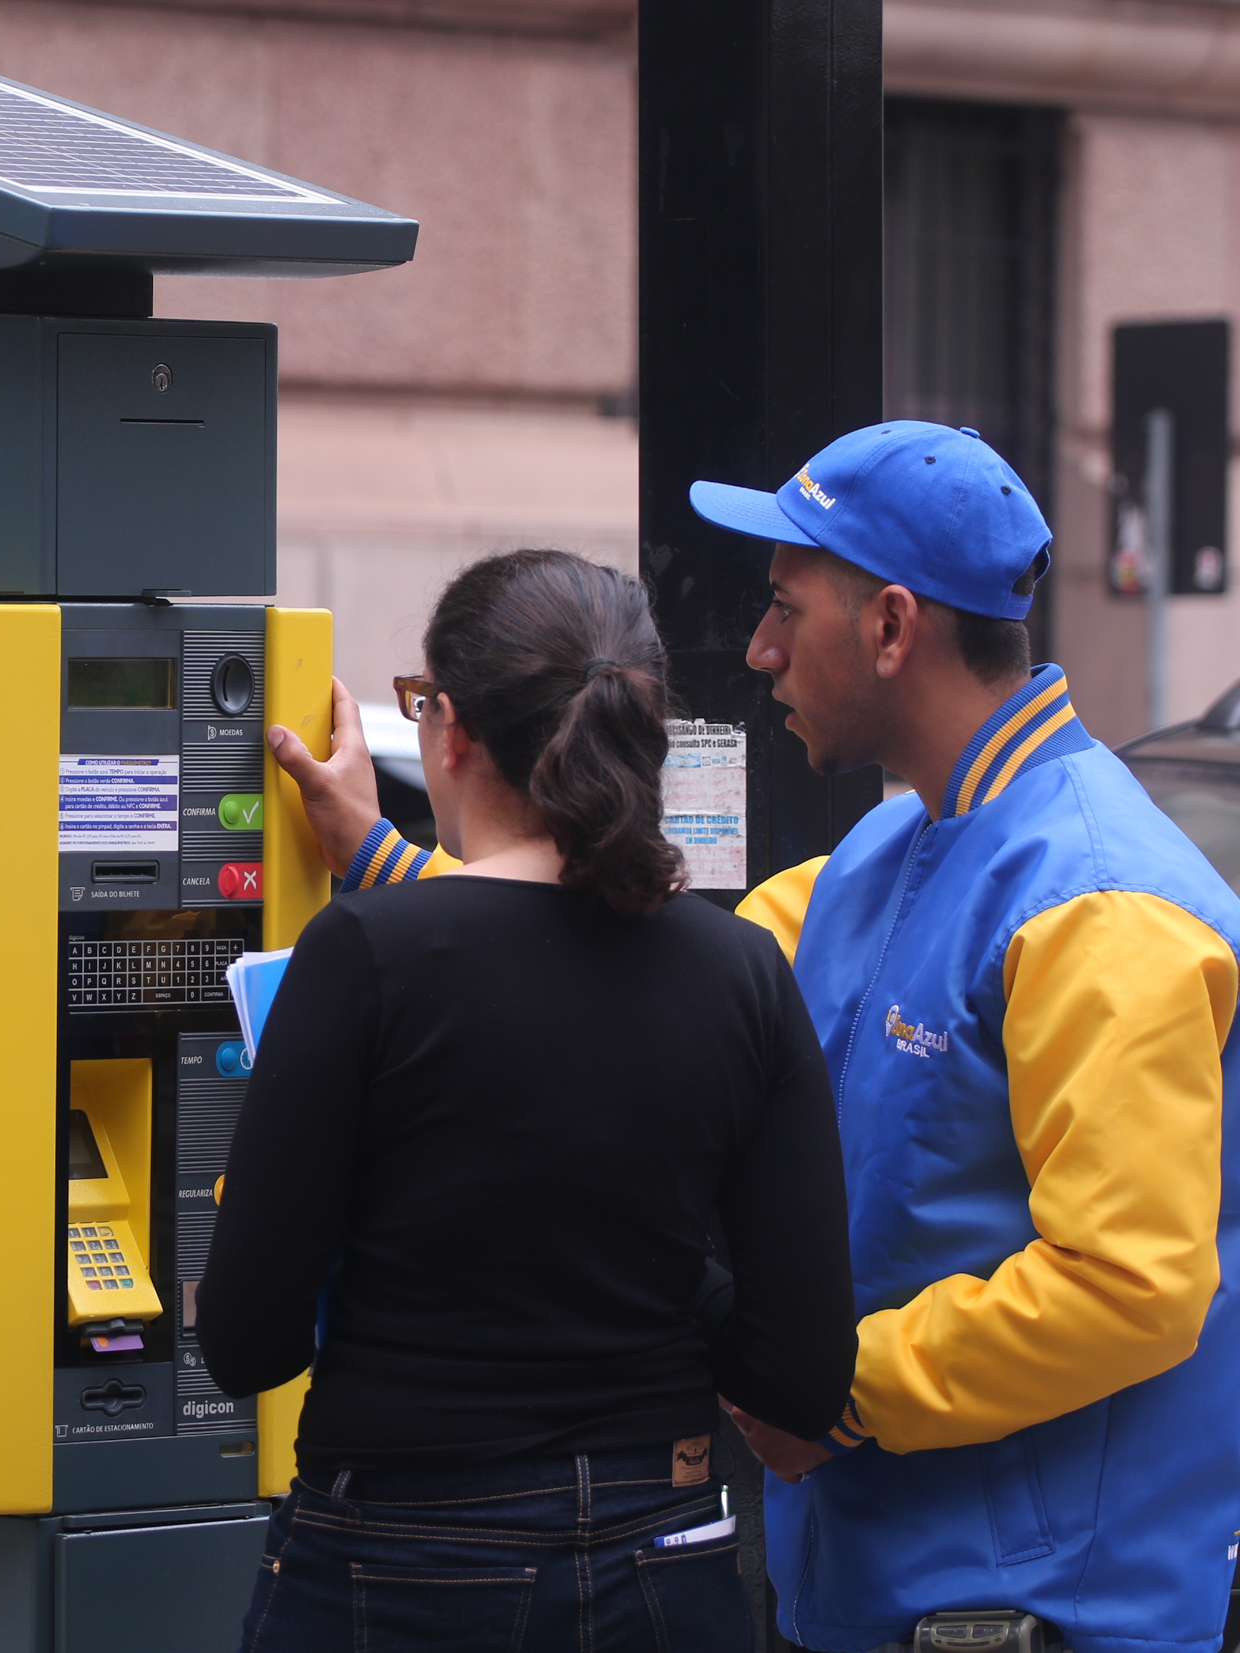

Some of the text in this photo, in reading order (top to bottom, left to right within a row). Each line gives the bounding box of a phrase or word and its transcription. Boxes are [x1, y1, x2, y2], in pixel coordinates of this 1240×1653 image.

[699, 725, 705, 735] DE
[701, 739, 711, 748] SPC
[717, 739, 737, 748] SERASA
[183, 807, 216, 816] CONFIRMA
[696, 816, 705, 824] DE
[707, 815, 739, 824] CRÉDITO
[183, 877, 210, 886] CANCELA
[91, 889, 108, 898] SAÍDA
[896, 1039, 930, 1058] BRASIL
[181, 1056, 203, 1064] TEMPO
[178, 1189, 213, 1198] REGULARIZA
[183, 1401, 234, 1418] digicon
[72, 1422, 154, 1434] CARTÃO DE ESTACIONAMENTO
